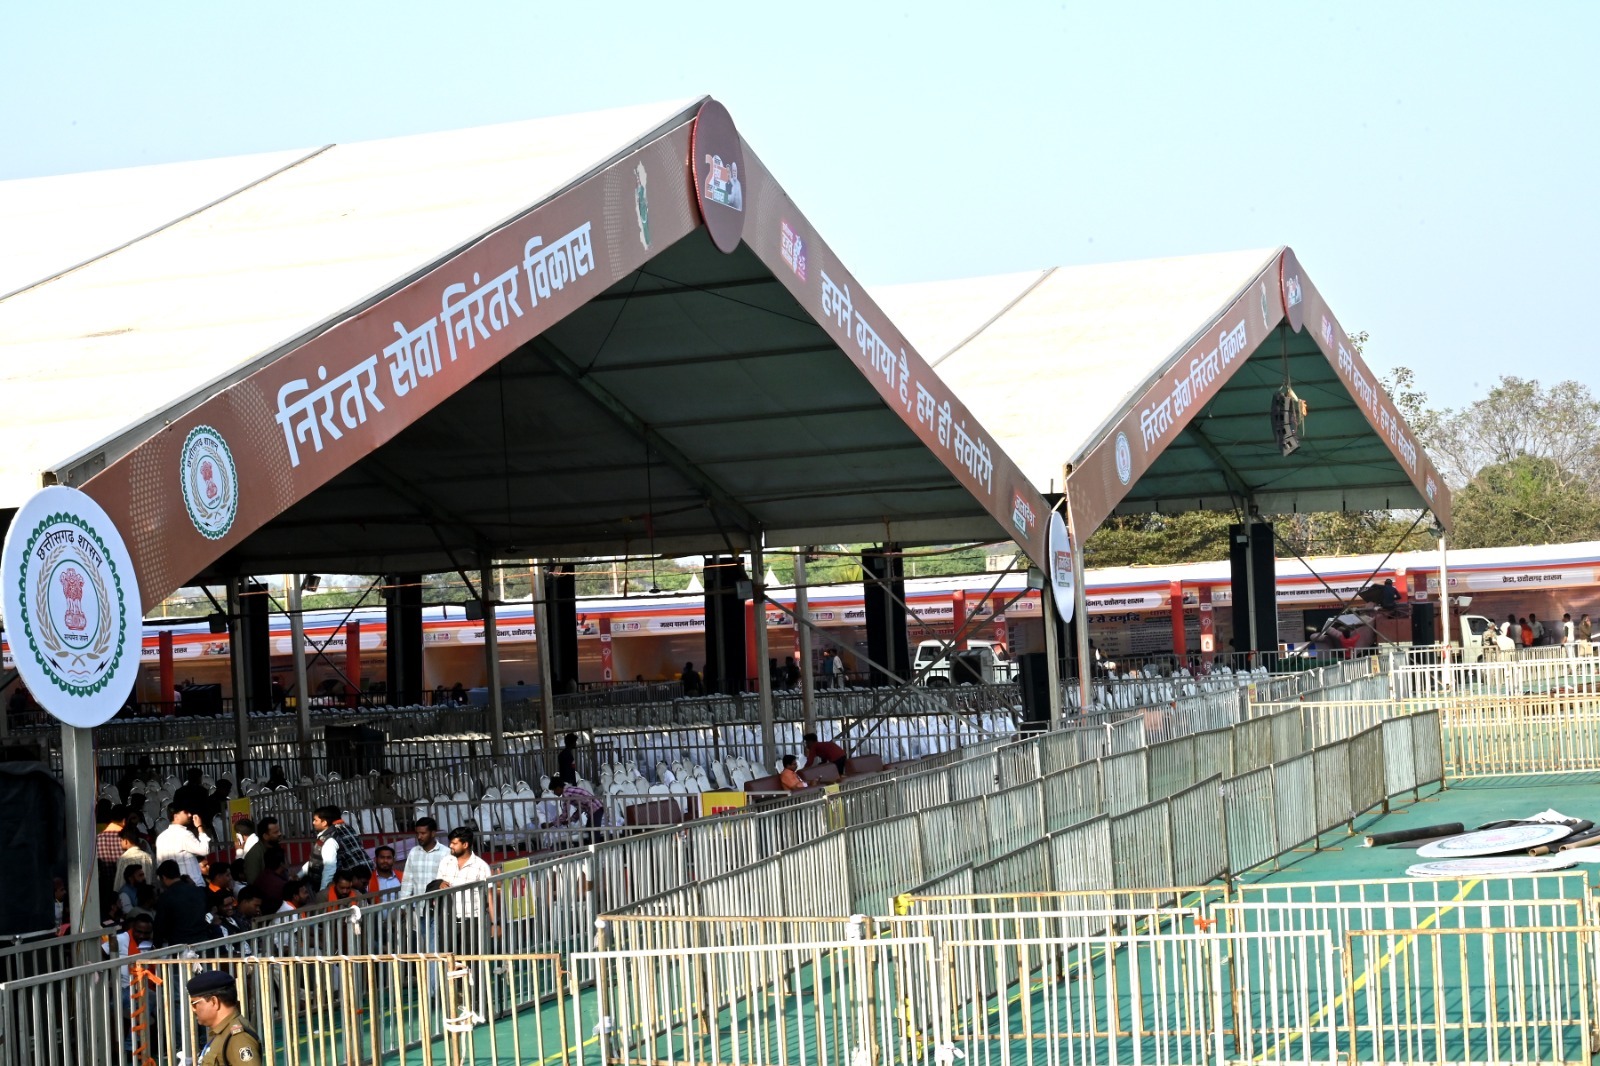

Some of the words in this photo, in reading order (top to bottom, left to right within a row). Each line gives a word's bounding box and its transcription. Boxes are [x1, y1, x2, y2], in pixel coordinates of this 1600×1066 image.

[275, 354, 386, 468] निरंतर
[383, 321, 442, 397] सेवा
[441, 266, 524, 362] निरंतर
[523, 220, 595, 308] विकास
[820, 269, 853, 339] हमने
[855, 310, 897, 389] बनाया
[916, 380, 936, 432] हम
[937, 400, 952, 449] ही
[953, 420, 993, 495] संवारेंगे
[1140, 396, 1174, 452] निरंतर
[1171, 378, 1192, 417] सेवा
[1189, 347, 1220, 399] निरंतर
[1218, 319, 1247, 369] विकास
[1338, 341, 1353, 382] हमने
[1353, 364, 1372, 410] बनाया
[1380, 404, 1390, 435] हम
[1390, 415, 1397, 446] ही
[77, 534, 103, 568] शासन
